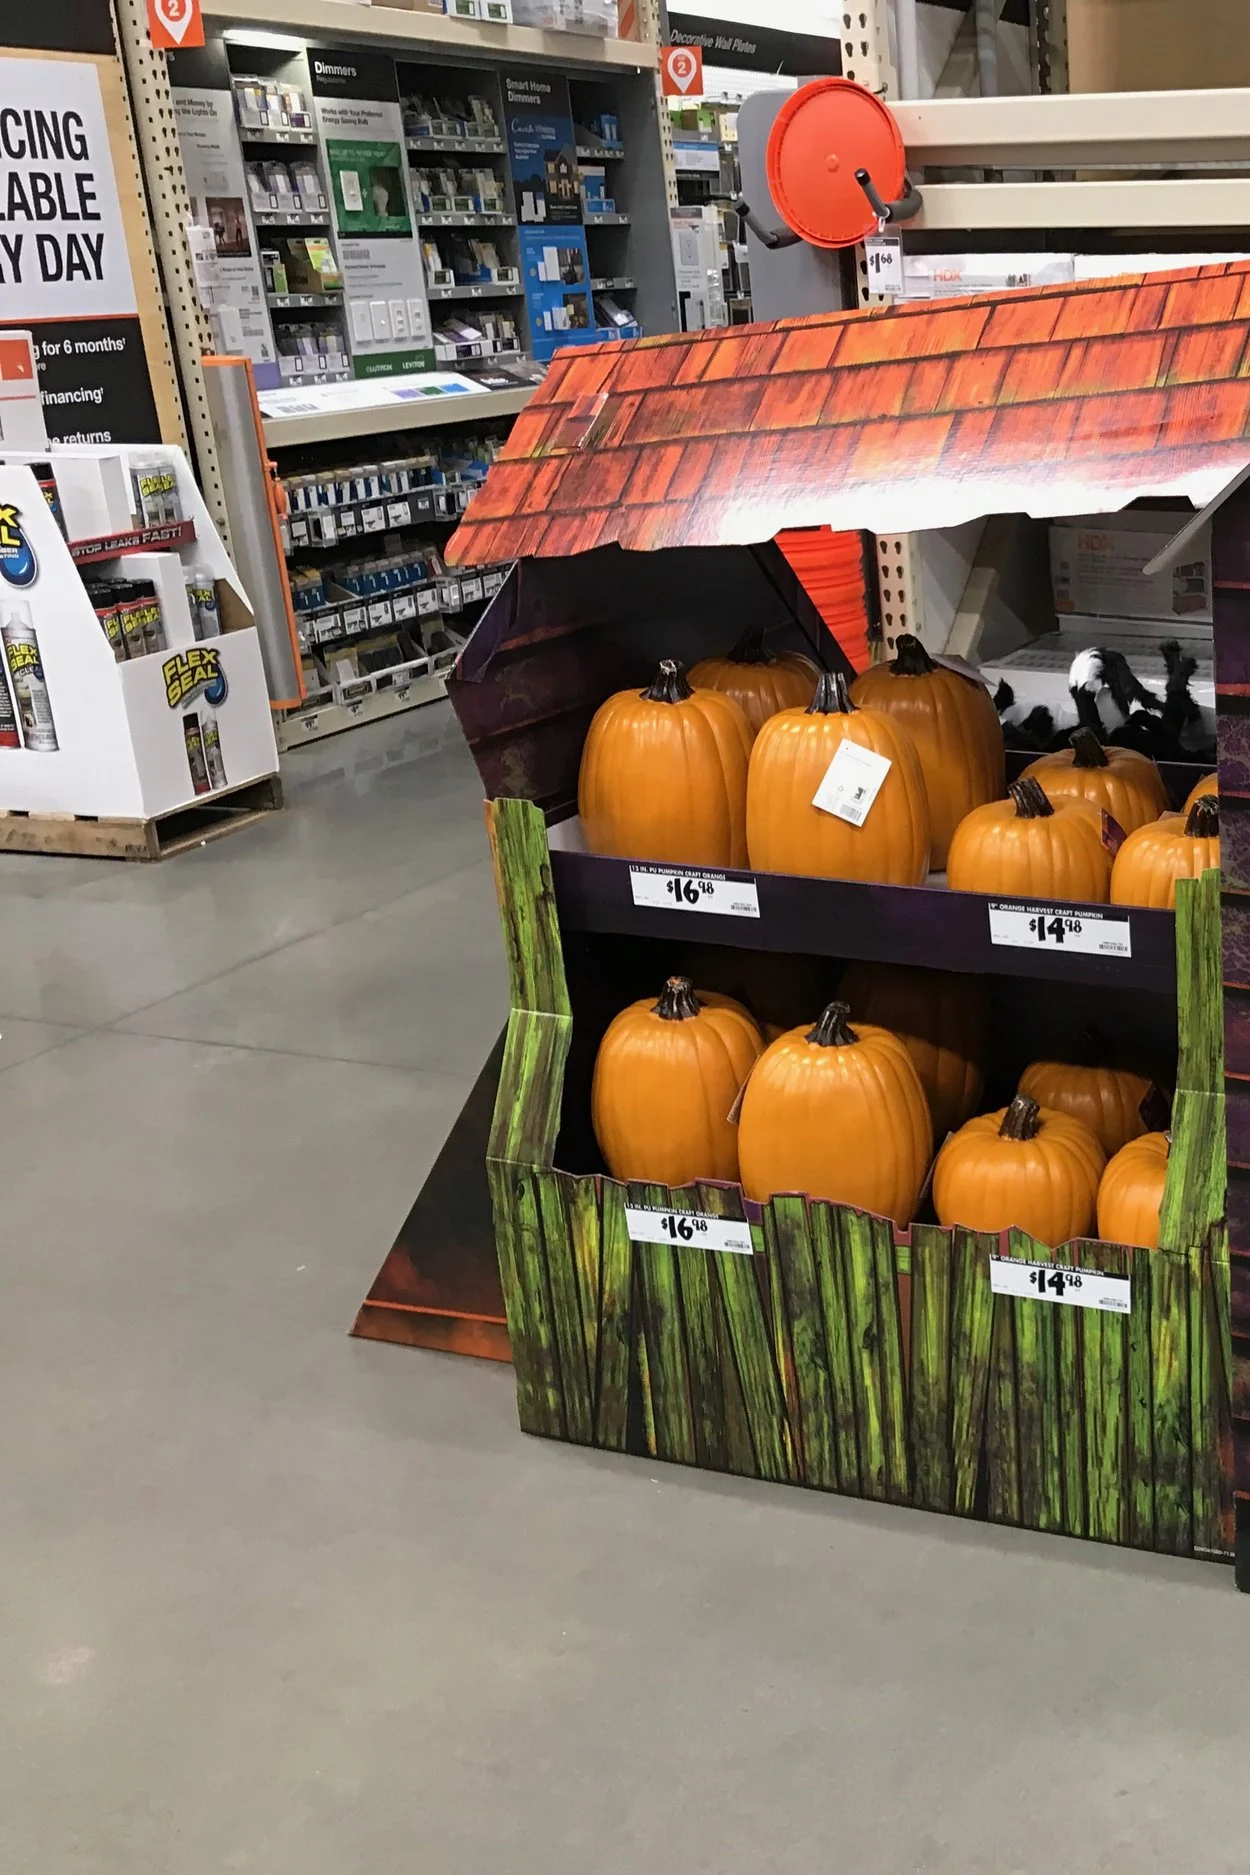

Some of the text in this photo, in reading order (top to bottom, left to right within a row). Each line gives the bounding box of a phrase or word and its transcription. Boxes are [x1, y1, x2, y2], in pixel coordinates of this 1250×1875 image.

[168, 0, 180, 17] 2
[670, 29, 757, 54] Decorative Wall Plates
[314, 61, 357, 77] Dimmers
[678, 62, 687, 74] 2
[506, 78, 551, 93] Smart Home
[508, 91, 541, 104] Dimmers
[0, 108, 89, 161] CING
[0, 171, 101, 221] ABLE
[36, 233, 104, 282] DAY
[934, 269, 962, 282] HDX
[42, 341, 61, 356] for
[63, 340, 73, 354] 6
[63, 431, 111, 444] returns
[71, 544, 102, 556] STOP
[104, 536, 139, 550] LEAKS
[1077, 533, 1117, 551] HDX
[7, 643, 38, 657] FLEX
[10, 655, 40, 672] SEAL
[162, 648, 219, 684] FLEX
[167, 664, 218, 708] SEAL
[658, 868, 684, 876] PUMPKIN
[702, 872, 726, 880] ORANGE
[999, 904, 1025, 912] ORANGE
[1026, 906, 1053, 915] HARVEST
[1055, 909, 1073, 917] CRAFT
[1074, 911, 1103, 919] PUMPKIN
[652, 1205, 677, 1214] PUMPKIN
[1000, 1256, 1026, 1264] ORANGE
[1027, 1258, 1054, 1267] HARVEST
[1075, 1266, 1104, 1275] PUMPKIN
